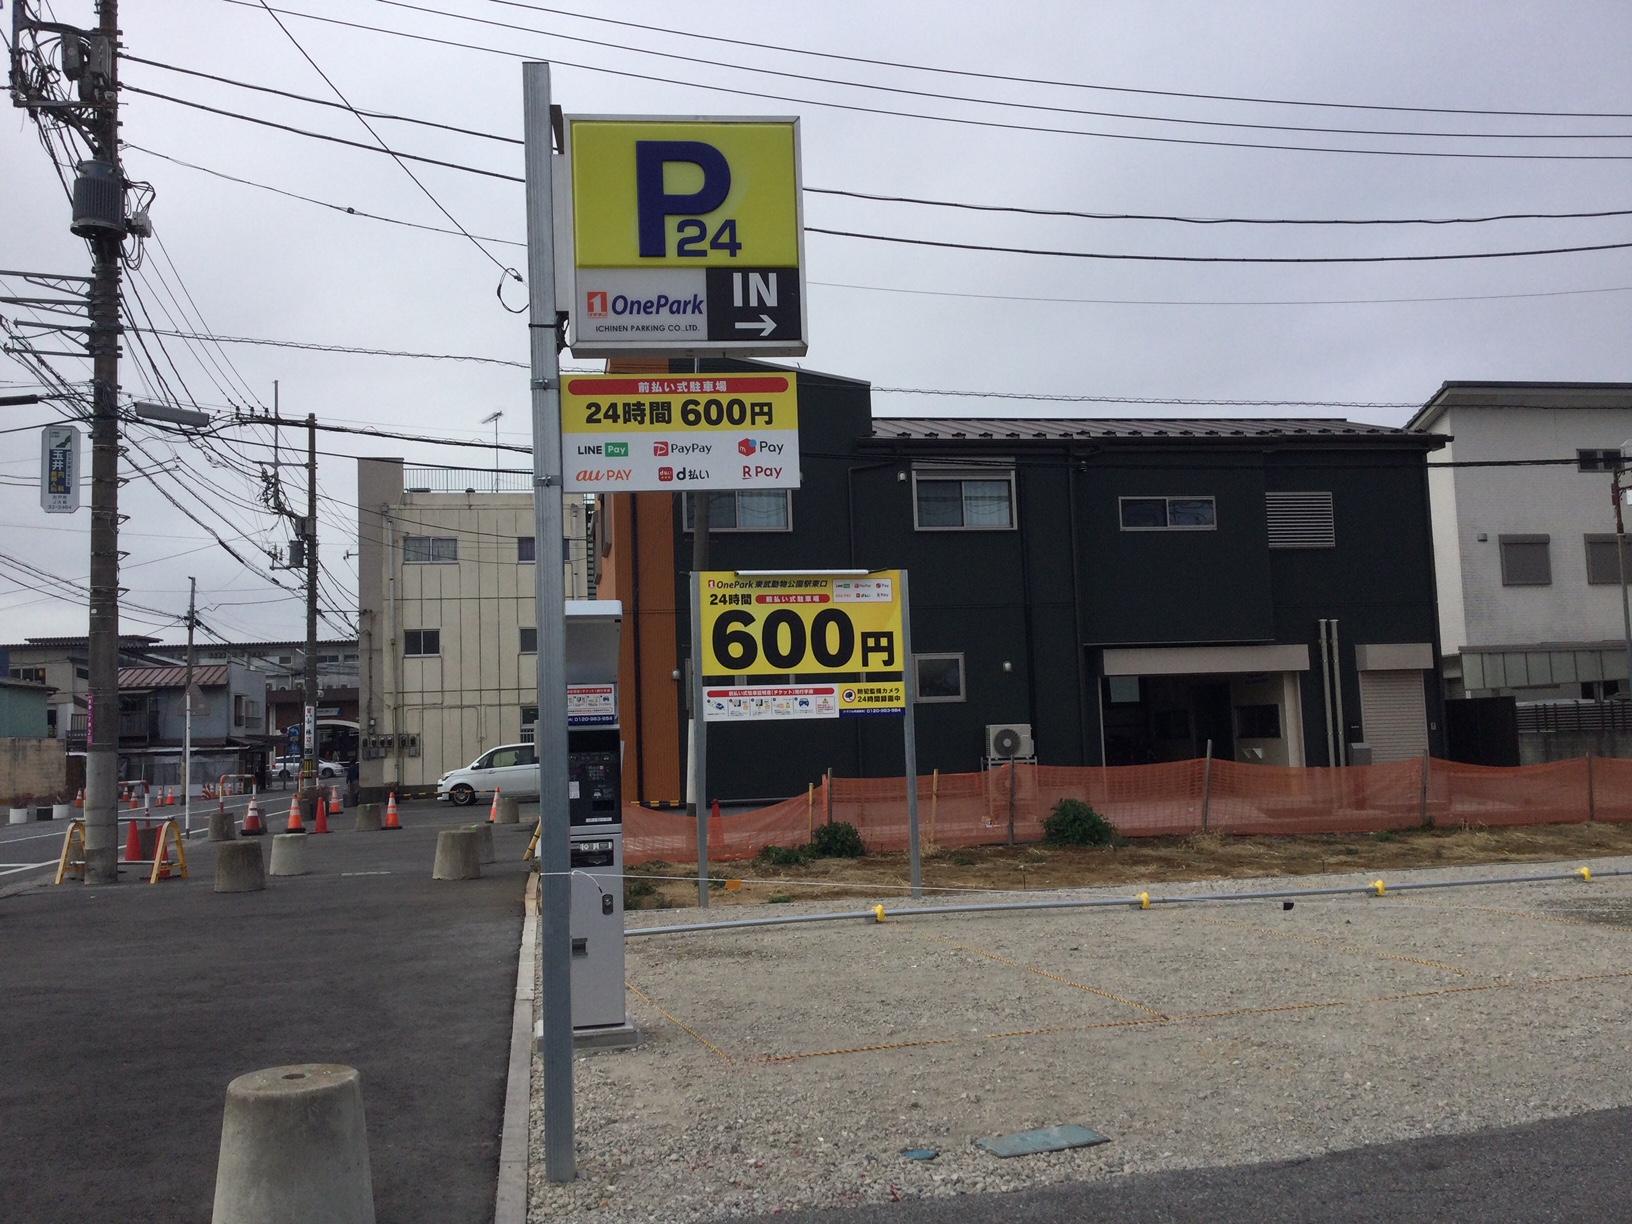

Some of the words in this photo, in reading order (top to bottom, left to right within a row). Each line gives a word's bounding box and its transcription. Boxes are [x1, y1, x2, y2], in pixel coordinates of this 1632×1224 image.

[636, 141, 731, 257] P
[677, 219, 742, 257] 24
[733, 272, 778, 307] IN
[612, 294, 704, 315] OnePark
[638, 381, 727, 393] 前払い式駐車場
[585, 402, 672, 425] 24時間
[681, 399, 773, 426] 600円
[578, 445, 602, 455] LINE
[608, 446, 625, 455] Pay
[671, 443, 712, 455] PayPay
[760, 441, 784, 455] Pay
[575, 469, 605, 481] au
[607, 469, 632, 480] PAY
[676, 467, 710, 480] d払い
[742, 465, 752, 480] R
[755, 466, 782, 479] Pay
[716, 580, 753, 588] OnePark
[710, 593, 752, 605] 24時間
[712, 608, 895, 669] 600円
